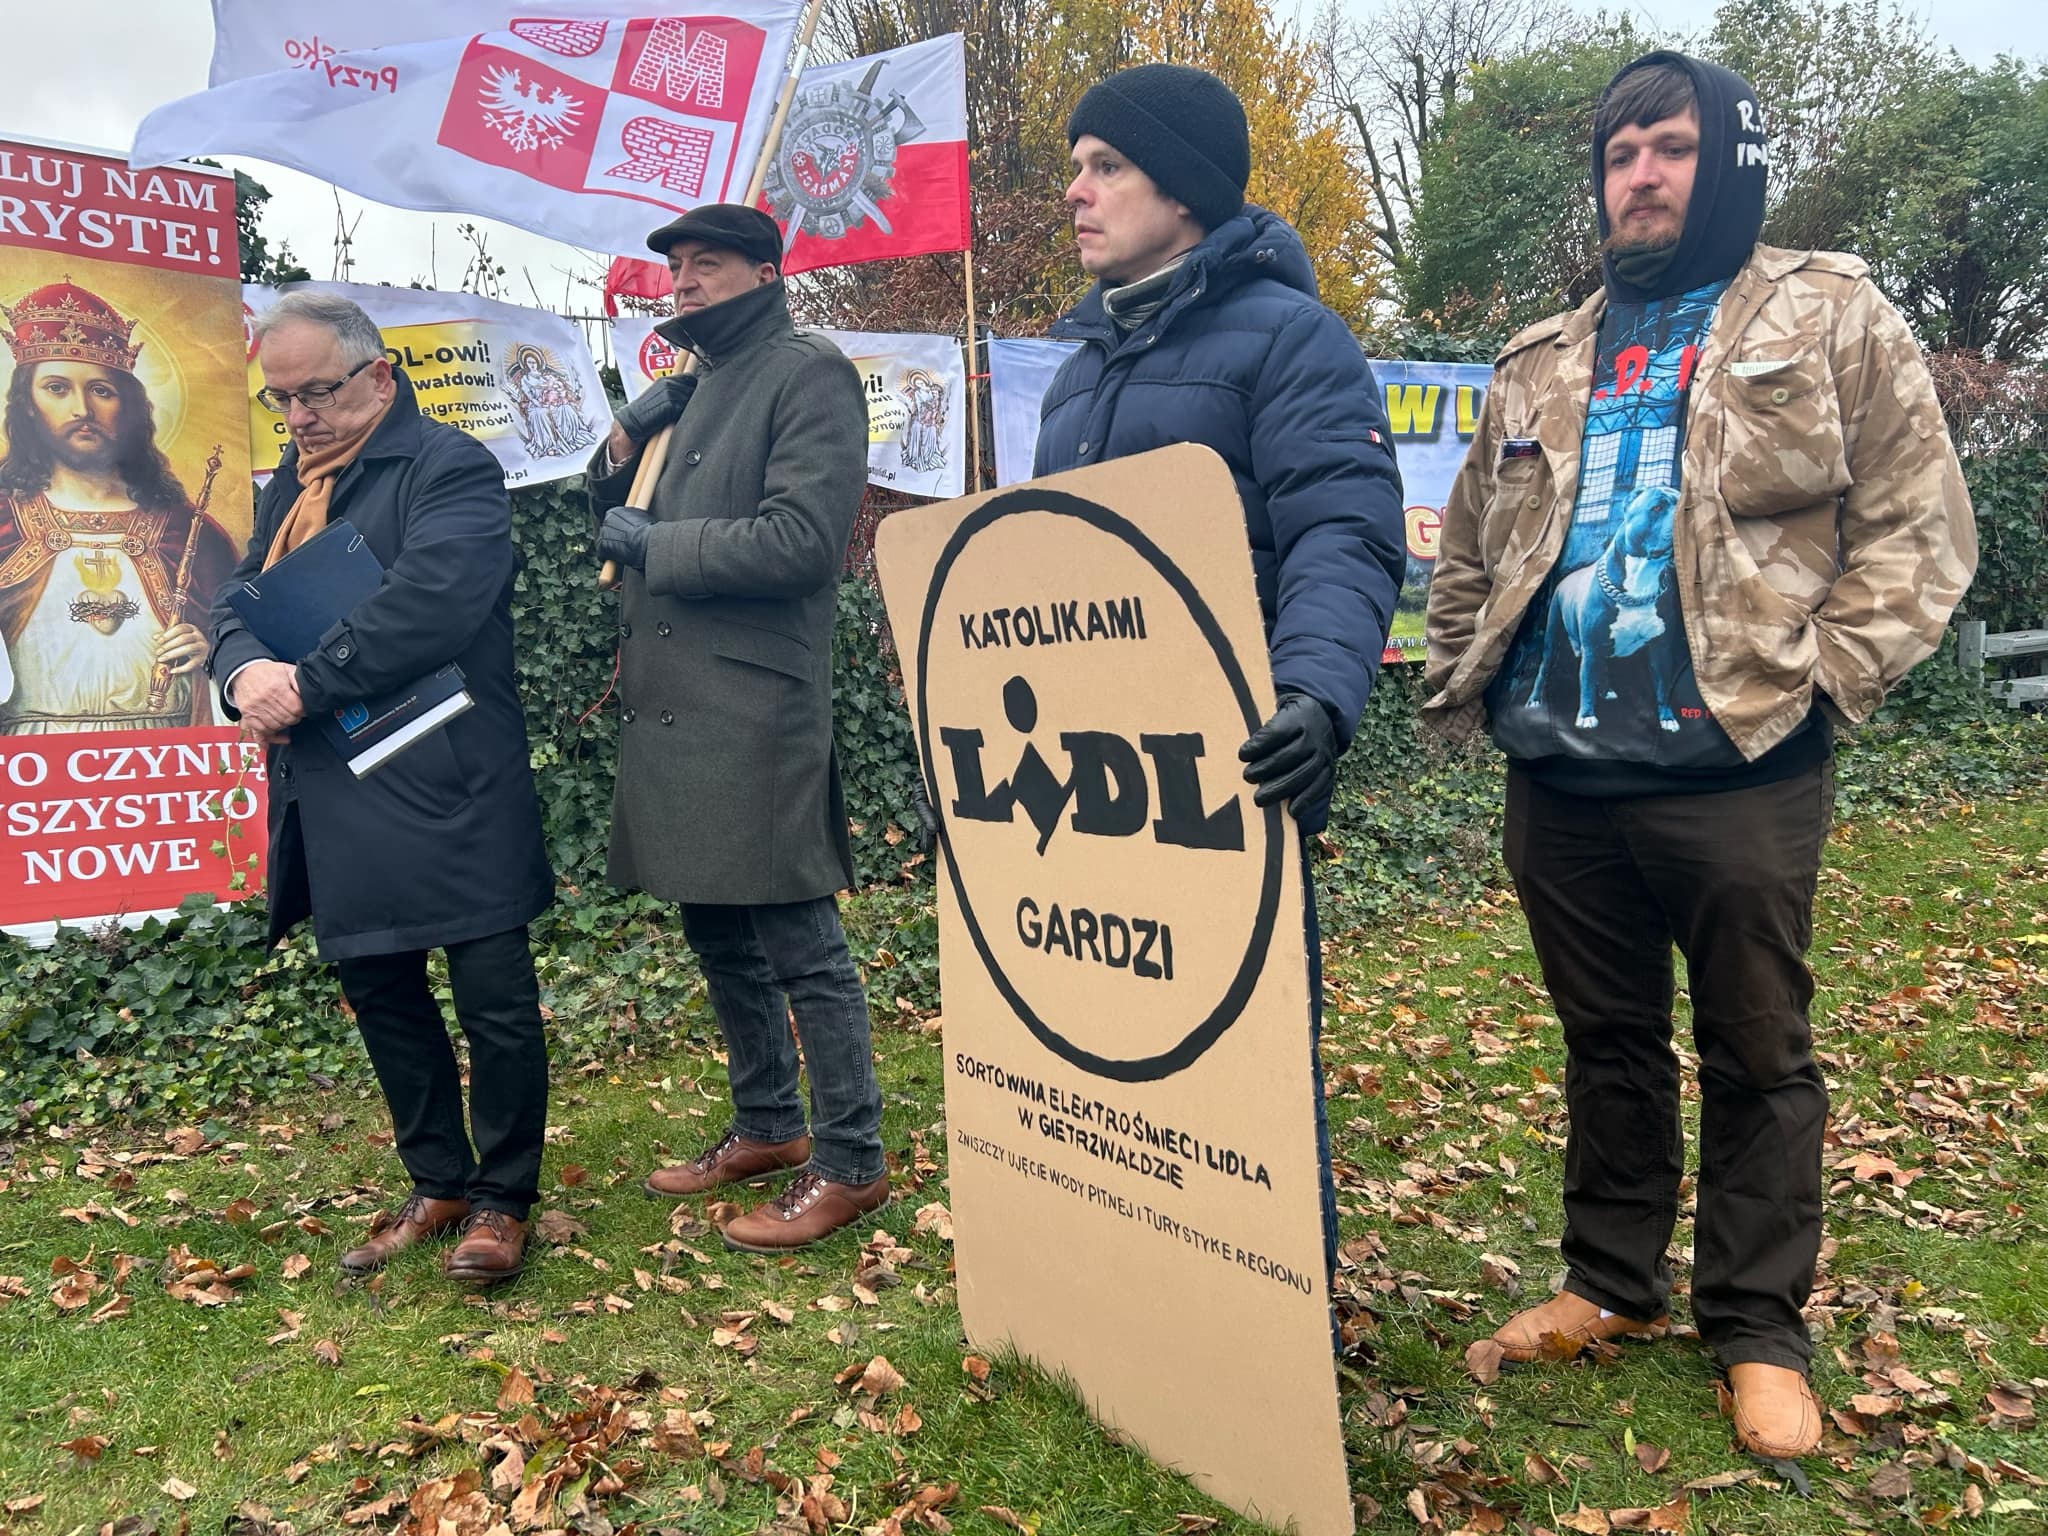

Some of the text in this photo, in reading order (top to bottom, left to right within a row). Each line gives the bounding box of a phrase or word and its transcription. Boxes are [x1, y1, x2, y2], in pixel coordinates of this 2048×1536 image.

[102, 166, 219, 213] NAM
[1386, 384, 1440, 435] W
[1404, 505, 1447, 560] G
[959, 596, 1148, 650] KATOLIKAMI
[0, 751, 48, 787] O
[0, 786, 259, 837] SZYSTKO
[21, 837, 201, 885] NOWE
[1015, 896, 1174, 981] GARDZI
[956, 1053, 1272, 1191] SORTOWNIA ELEKTROŚMIECI LIDLA
[1017, 1106, 1184, 1190] W GIETRZWAŁDZIE
[957, 1129, 1005, 1162] ZNISZCZY
[1008, 1150, 1048, 1181] UJĘCIE
[1049, 1167, 1085, 1198] WODY
[1088, 1183, 1134, 1219] PITNEJ
[1236, 1248, 1312, 1294] REGIONU
